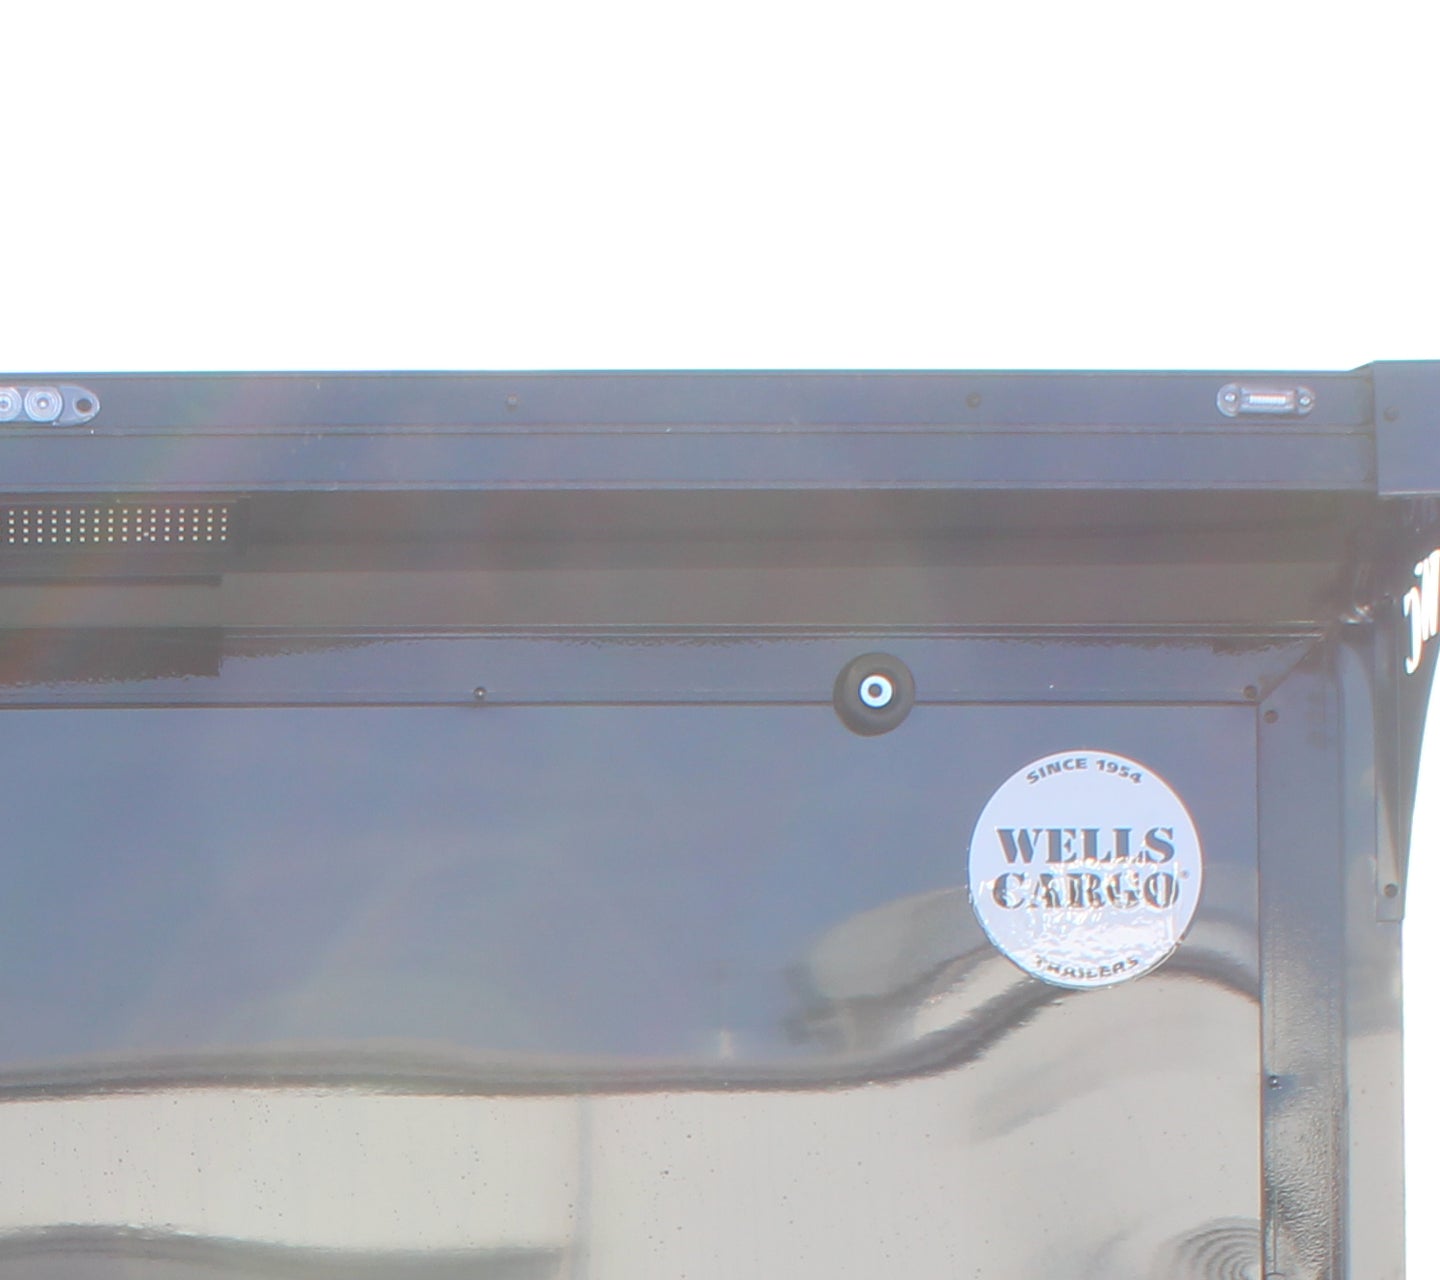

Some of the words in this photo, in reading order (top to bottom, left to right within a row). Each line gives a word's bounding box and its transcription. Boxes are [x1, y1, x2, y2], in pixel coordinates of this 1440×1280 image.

[1026, 757, 1087, 784] SINCE
[1096, 759, 1142, 784] 1954
[995, 827, 1176, 864] WELLS
[992, 871, 1180, 909] CARGO
[1035, 954, 1140, 979] TRAILERS
